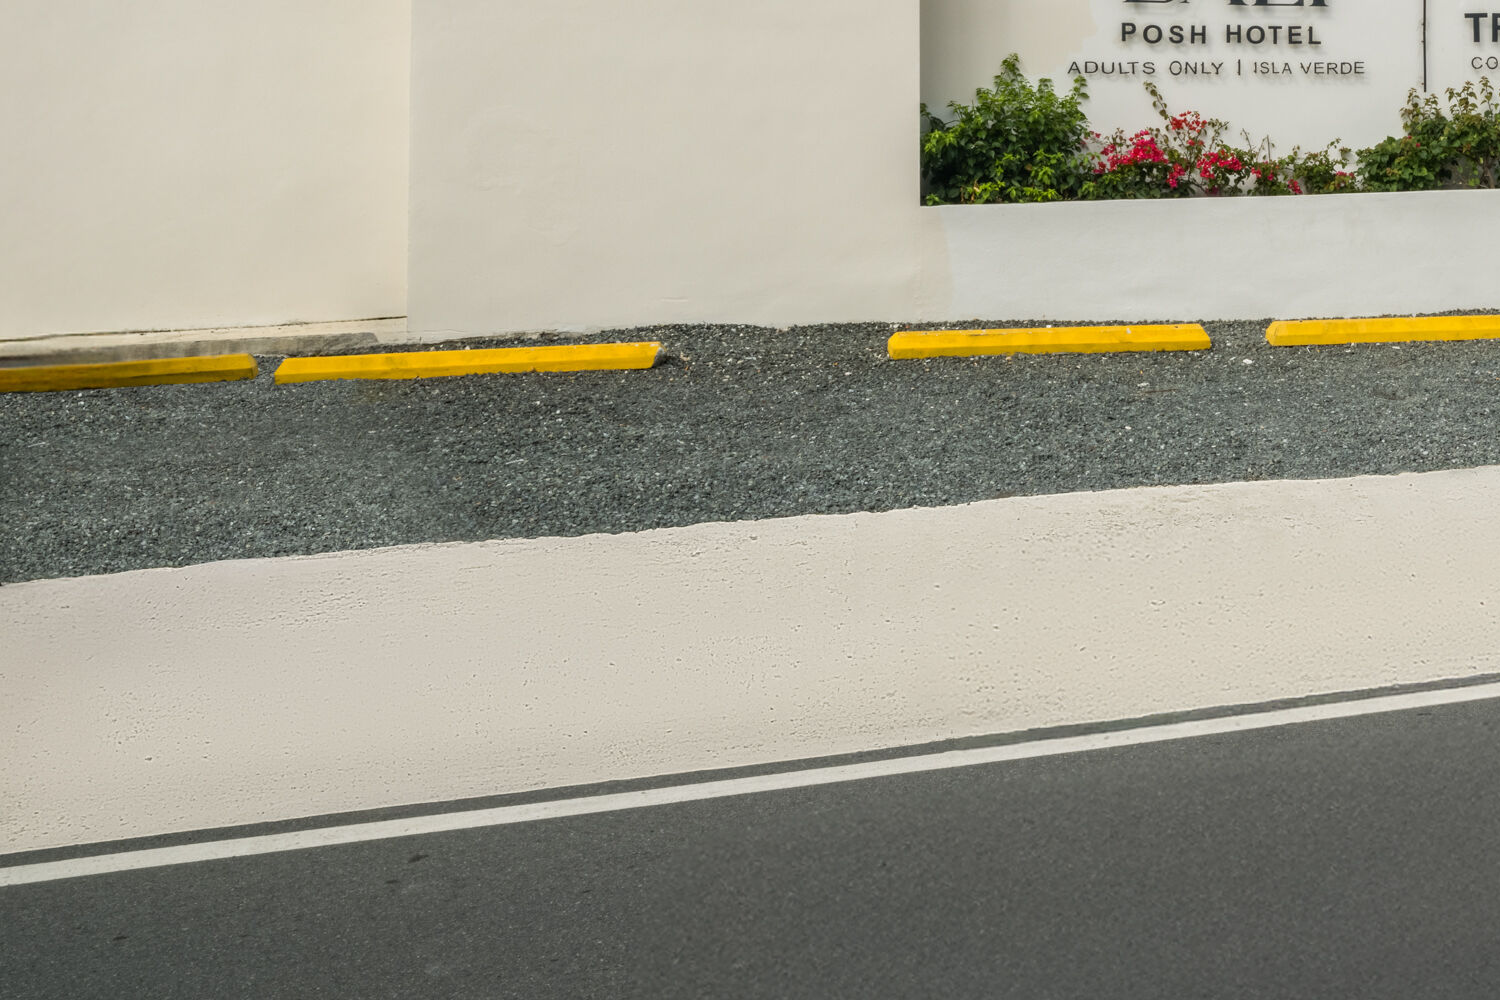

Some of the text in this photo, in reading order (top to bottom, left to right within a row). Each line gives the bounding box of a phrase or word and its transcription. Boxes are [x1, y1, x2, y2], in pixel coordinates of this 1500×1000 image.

[1121, 22, 1322, 45] POSH HOTEL
[1067, 61, 1156, 75] ADULTS
[1169, 60, 1224, 76] ONLY
[1253, 61, 1292, 75] ISLA
[1300, 61, 1366, 75] VERDE
